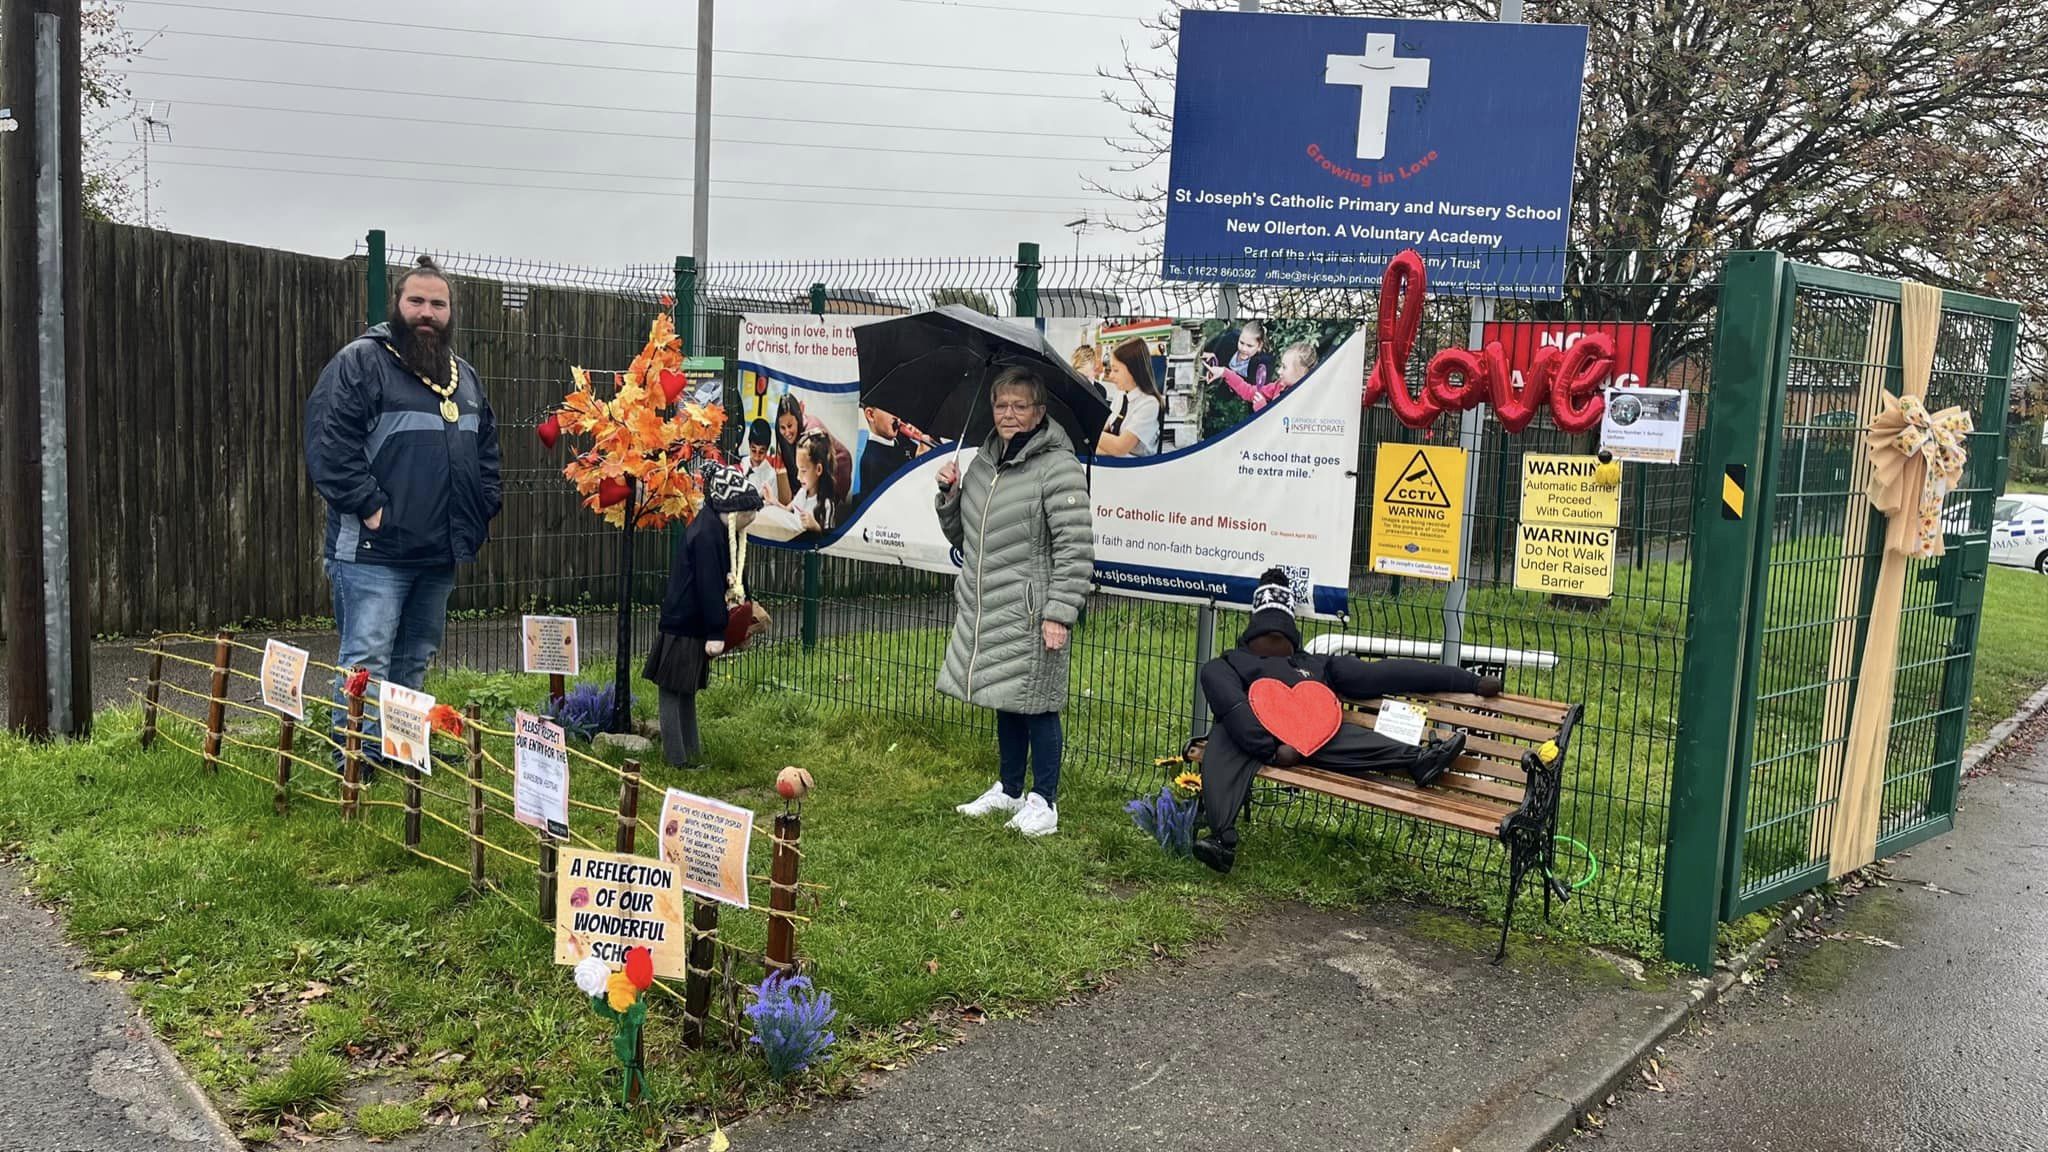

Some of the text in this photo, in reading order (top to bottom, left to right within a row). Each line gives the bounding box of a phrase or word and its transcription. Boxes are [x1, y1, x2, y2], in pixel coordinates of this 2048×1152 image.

[1306, 143, 1438, 187] Growing in Love
[1175, 188, 1562, 221] St Joseph's Catholic Primary and Nursery School
[1226, 218, 1502, 248] New Ollerton. A Voluntary Academy
[1244, 246, 1268, 259] Part
[1271, 247, 1284, 259] of
[1286, 248, 1305, 260] the
[1306, 250, 1355, 265] Aquinas
[1450, 256, 1481, 270] Trust
[745, 322, 788, 340] Growing
[791, 325, 801, 338] in
[803, 324, 829, 340] love,
[832, 325, 846, 340] in
[745, 340, 859, 357] of Christ, for the bene
[1291, 424, 1345, 433] INSPECTORATE
[1252, 451, 1288, 463] school
[1291, 453, 1311, 464] that
[1313, 456, 1340, 467] goes
[1238, 465, 1254, 475] the
[1257, 467, 1283, 477] extra
[1528, 460, 1597, 477] WARNIN
[1398, 488, 1437, 501] CCTV
[1526, 480, 1617, 493] Automatic Barrier
[1548, 494, 1592, 506] Proceed
[1096, 505, 1268, 533] for Catholic life and Mission
[1388, 505, 1446, 521] WARNING
[1536, 506, 1603, 519] With Caution
[881, 539, 905, 548] LOURDES
[1523, 526, 1609, 546] WARNING
[1992, 538, 2019, 549] MAS
[1102, 535, 1123, 547] faith
[1126, 538, 1145, 550] and
[1147, 540, 1193, 555] non-faith
[1195, 543, 1266, 562] backgrounds
[1525, 543, 1605, 561] Do Not Walk
[1521, 558, 1608, 577] Under Raised
[1092, 568, 1228, 596] w.stjosephsschool.net
[1541, 575, 1584, 589] Barrier
[522, 719, 560, 744] PLEASE RESPECT
[516, 734, 528, 749] OUR
[528, 738, 544, 755] ENTRY
[544, 745, 555, 759] FOR
[556, 750, 566, 764] THE
[570, 858, 672, 889] A REFLECTION
[595, 887, 654, 913] OF OUR
[574, 912, 665, 941] WONDERFUL
